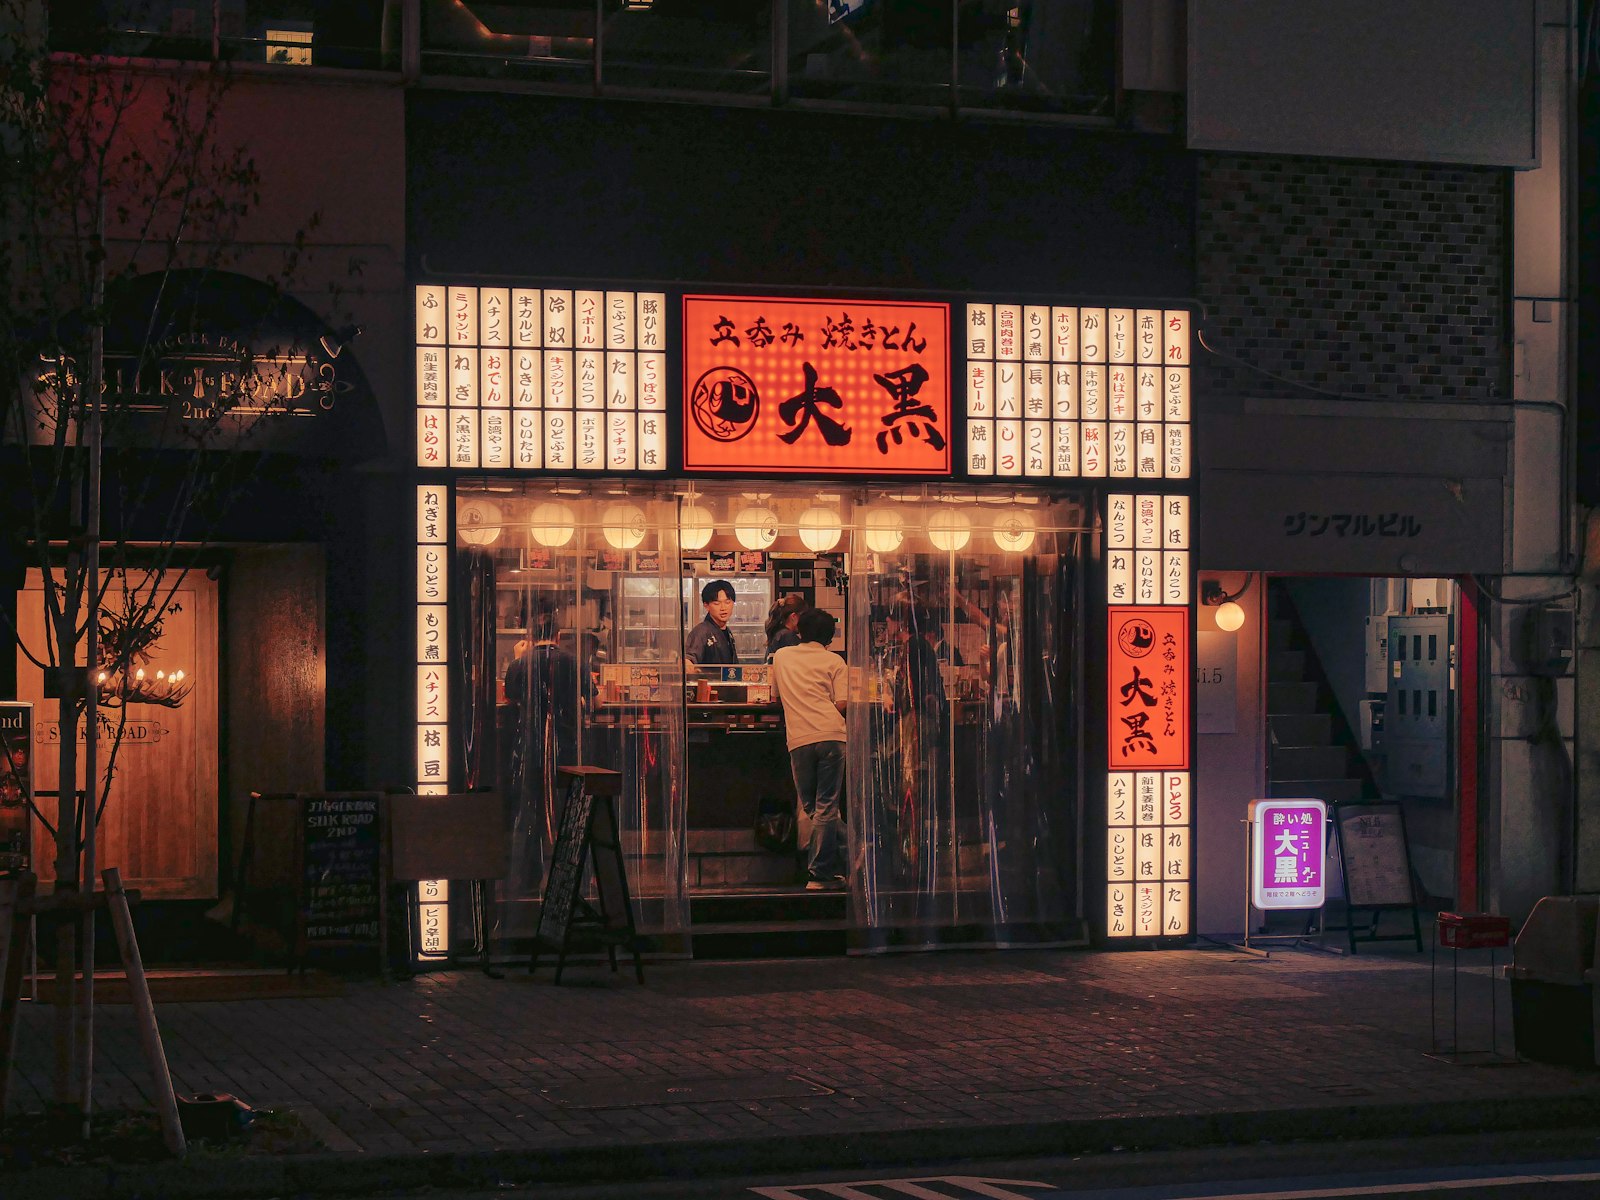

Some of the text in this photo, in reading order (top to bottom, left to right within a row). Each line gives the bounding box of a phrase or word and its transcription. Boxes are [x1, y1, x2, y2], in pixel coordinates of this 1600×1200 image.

[423, 293, 438, 339] ふわ
[456, 293, 469, 340] ミノサンド
[488, 296, 501, 340] ハチノス
[518, 296, 533, 342] 牛カルビ
[549, 297, 565, 342] 冷奴
[582, 298, 595, 343] ハイボール
[612, 299, 626, 344] こぶくろ
[643, 300, 657, 345] 豚ひれ
[709, 312, 927, 354] 立呑み 焼きとん
[971, 310, 986, 354] 枝豆
[1000, 310, 1013, 355] 台湾肉巻串
[1028, 312, 1042, 355] もつ煮
[1085, 314, 1098, 357] がつ
[1113, 315, 1125, 358] ソーセージ
[1141, 316, 1153, 358] 赤セン
[1169, 317, 1182, 359] ちれ
[455, 355, 471, 400] ねぎ
[488, 356, 501, 401] おでん
[520, 357, 532, 402] しきん
[550, 357, 564, 403] 牛スジカレー
[582, 358, 594, 403] なんこつ
[612, 359, 626, 404] たん
[644, 360, 657, 404] てっぽう
[971, 368, 985, 411] 生ビール
[1000, 369, 1014, 411] レバ
[1028, 369, 1043, 413] 長芋
[1056, 371, 1070, 412] はつ
[1085, 371, 1098, 414] 牛ゆでタン
[1113, 372, 1125, 414] ればテキ
[1141, 372, 1154, 415] なす
[1169, 373, 1182, 415] のどぶえ
[776, 361, 947, 455] 大黒
[424, 415, 438, 461] はらみ
[488, 416, 502, 462] 台湾やっこ
[520, 418, 533, 462] しいたけ
[551, 418, 565, 463] のどぶえ
[583, 418, 596, 464] ポテトサラダ
[613, 418, 626, 464] シマチョウ
[643, 419, 656, 464] ほほ
[971, 425, 986, 470] 焼酎
[1000, 427, 1014, 470] しろ
[1029, 428, 1042, 469] つくね
[1085, 428, 1098, 471] 豚バラ
[1113, 429, 1126, 472] ガツ芯
[1141, 429, 1155, 472] 角煮
[1169, 429, 1182, 473] 焼おにぎり
[424, 491, 439, 538] ねぎま
[1112, 500, 1125, 542] なんこつ
[1140, 500, 1153, 543] 台湾やっこ
[1168, 501, 1181, 543] ほほ
[426, 551, 438, 597] ししとう
[1112, 556, 1126, 598] ねぎ
[1140, 556, 1152, 598] しいたけ
[1168, 556, 1181, 598] なんこつ
[425, 613, 439, 657] もつ煮
[425, 671, 439, 716] ハチノス
[1161, 632, 1177, 737] 立呑み 焼きとん
[1119, 665, 1158, 758] 大黒
[424, 730, 440, 776] 枝豆
[1113, 778, 1126, 820] ハチノス
[1273, 812, 1312, 825] 酔い処
[1112, 833, 1125, 875] ししとう
[1140, 833, 1153, 875] ほほ
[1168, 833, 1182, 875] れば
[1274, 829, 1299, 883] 大黒
[1300, 830, 1310, 862] ニュー
[1112, 889, 1124, 931] しきん
[1140, 888, 1152, 931] 牛スジカレー
[1168, 888, 1181, 930] たん
